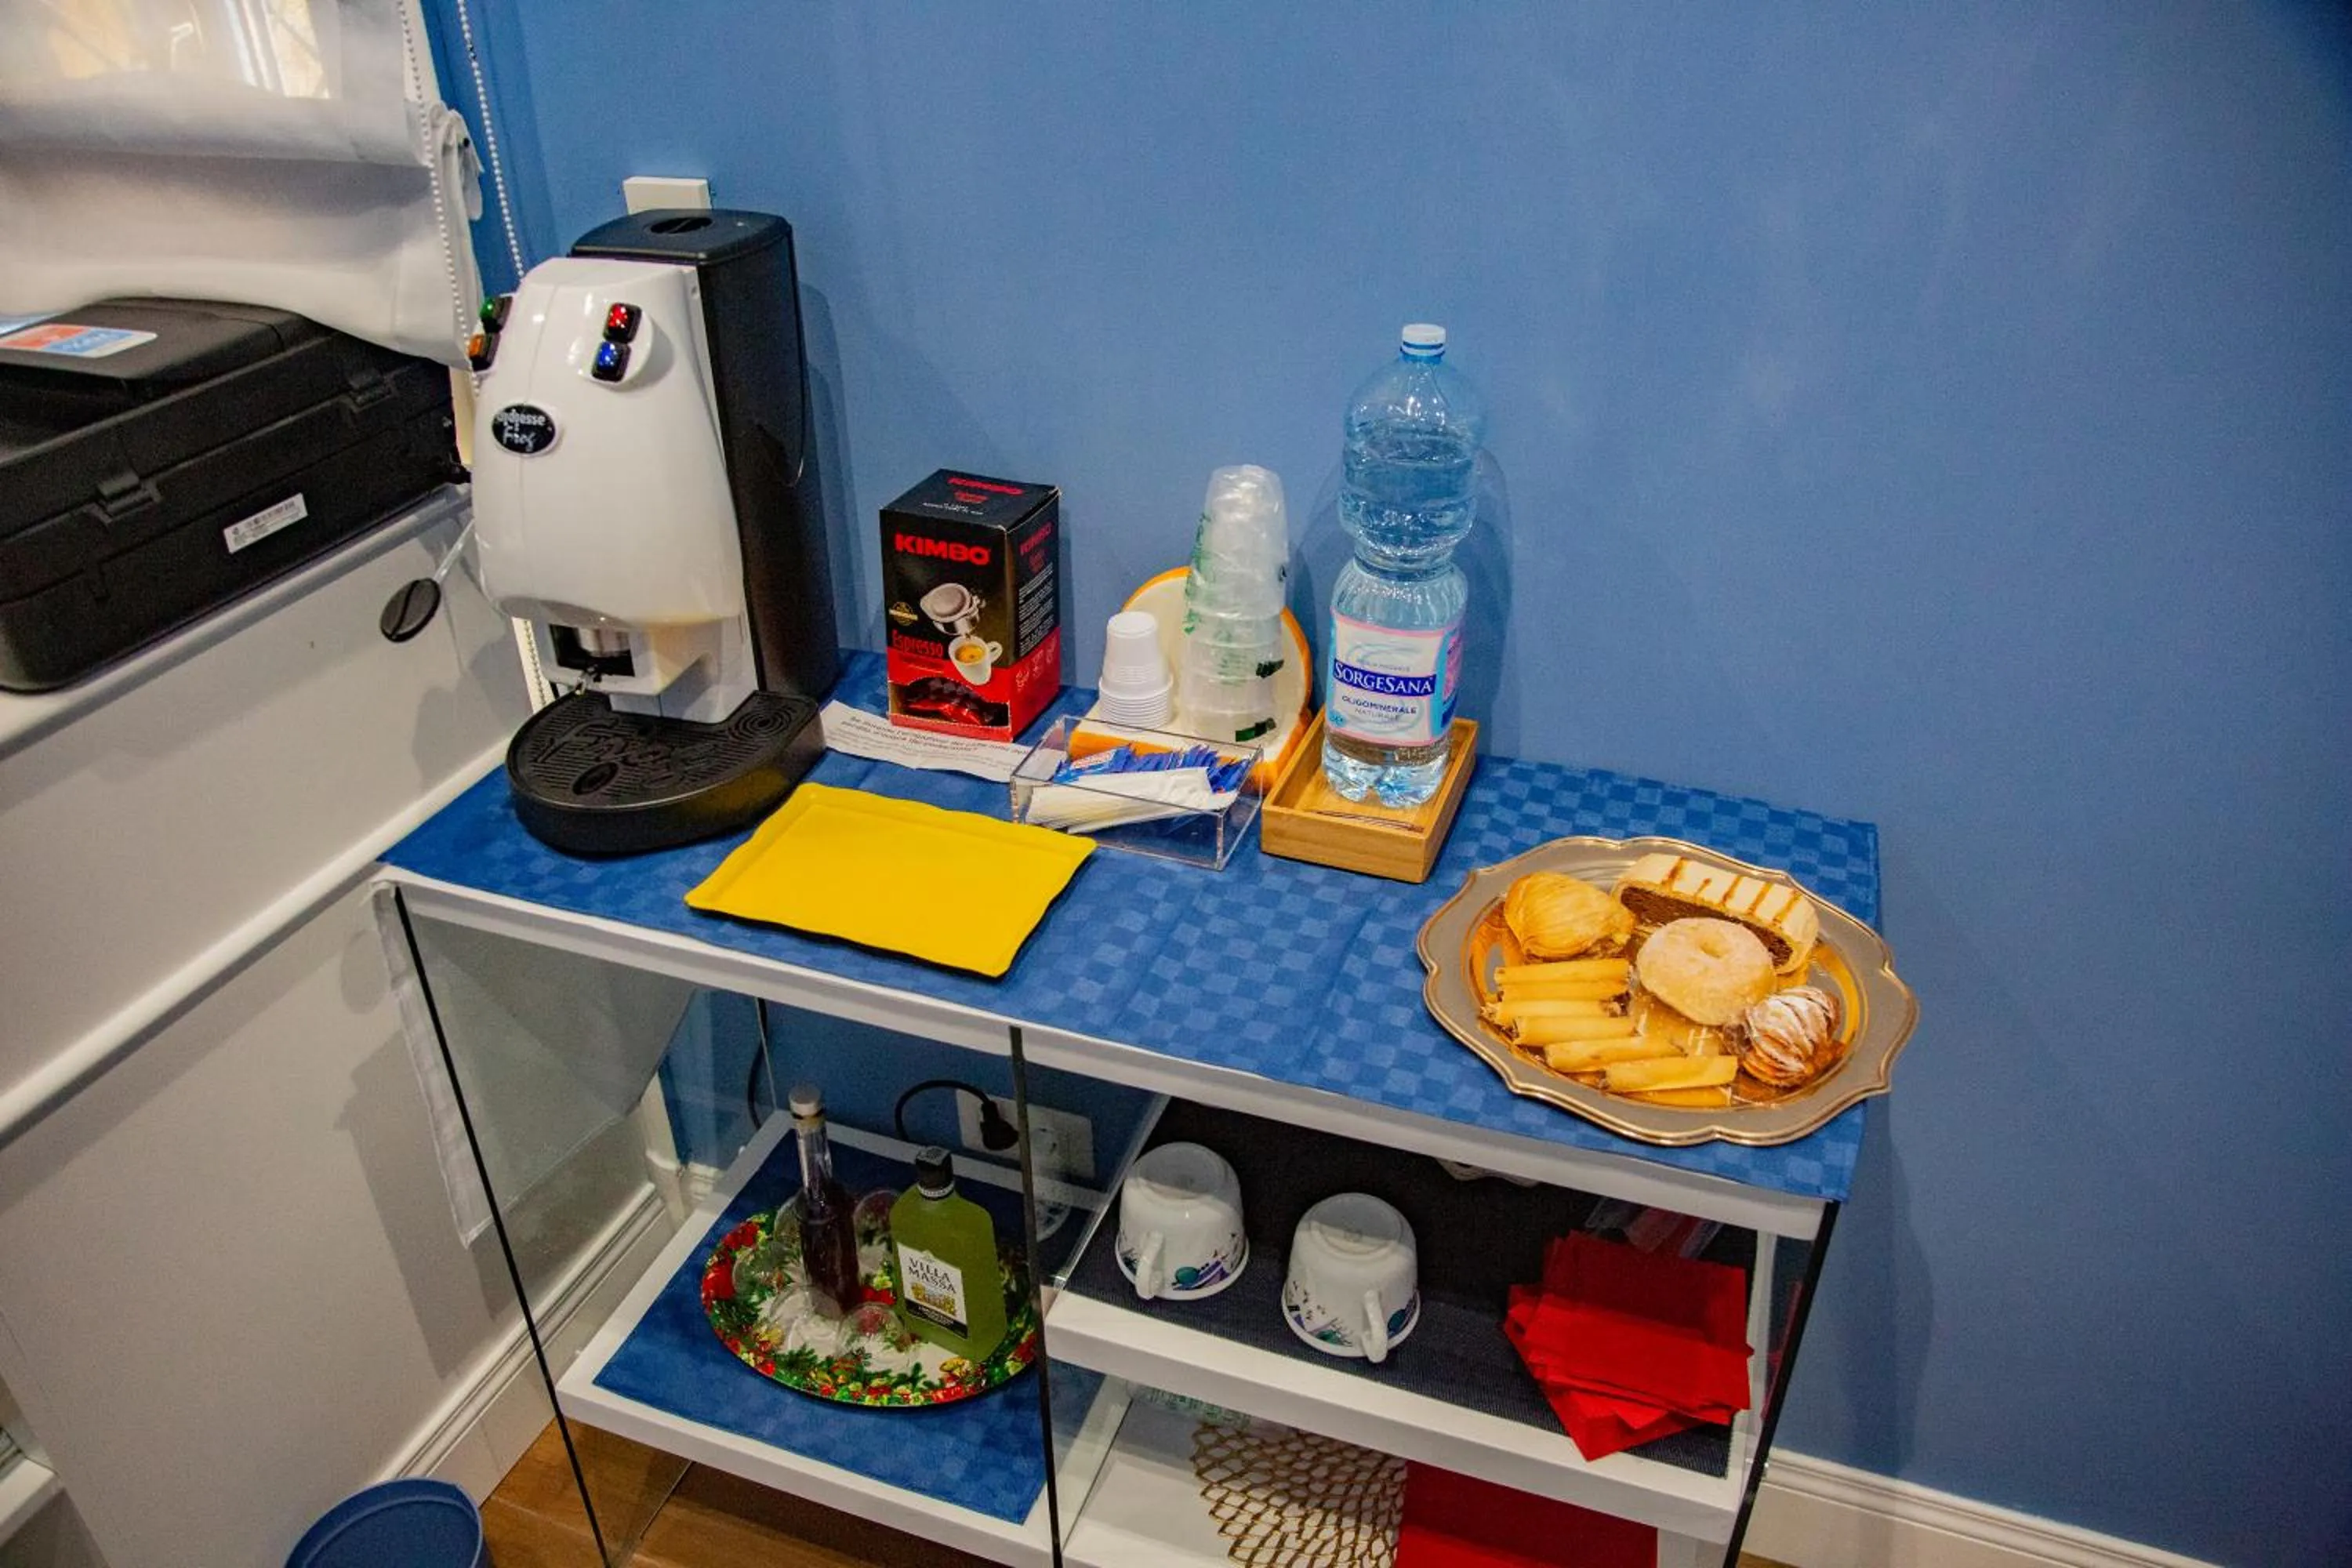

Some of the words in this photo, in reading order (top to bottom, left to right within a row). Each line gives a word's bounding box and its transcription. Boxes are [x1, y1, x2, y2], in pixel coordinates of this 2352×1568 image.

[895, 533, 990, 565] KIMBO
[1335, 662, 1433, 694] SORGESANA
[1341, 695, 1417, 714] OLIGOMINERALE
[908, 1265, 957, 1294] MASSA
[909, 1256, 951, 1283] VILLA
